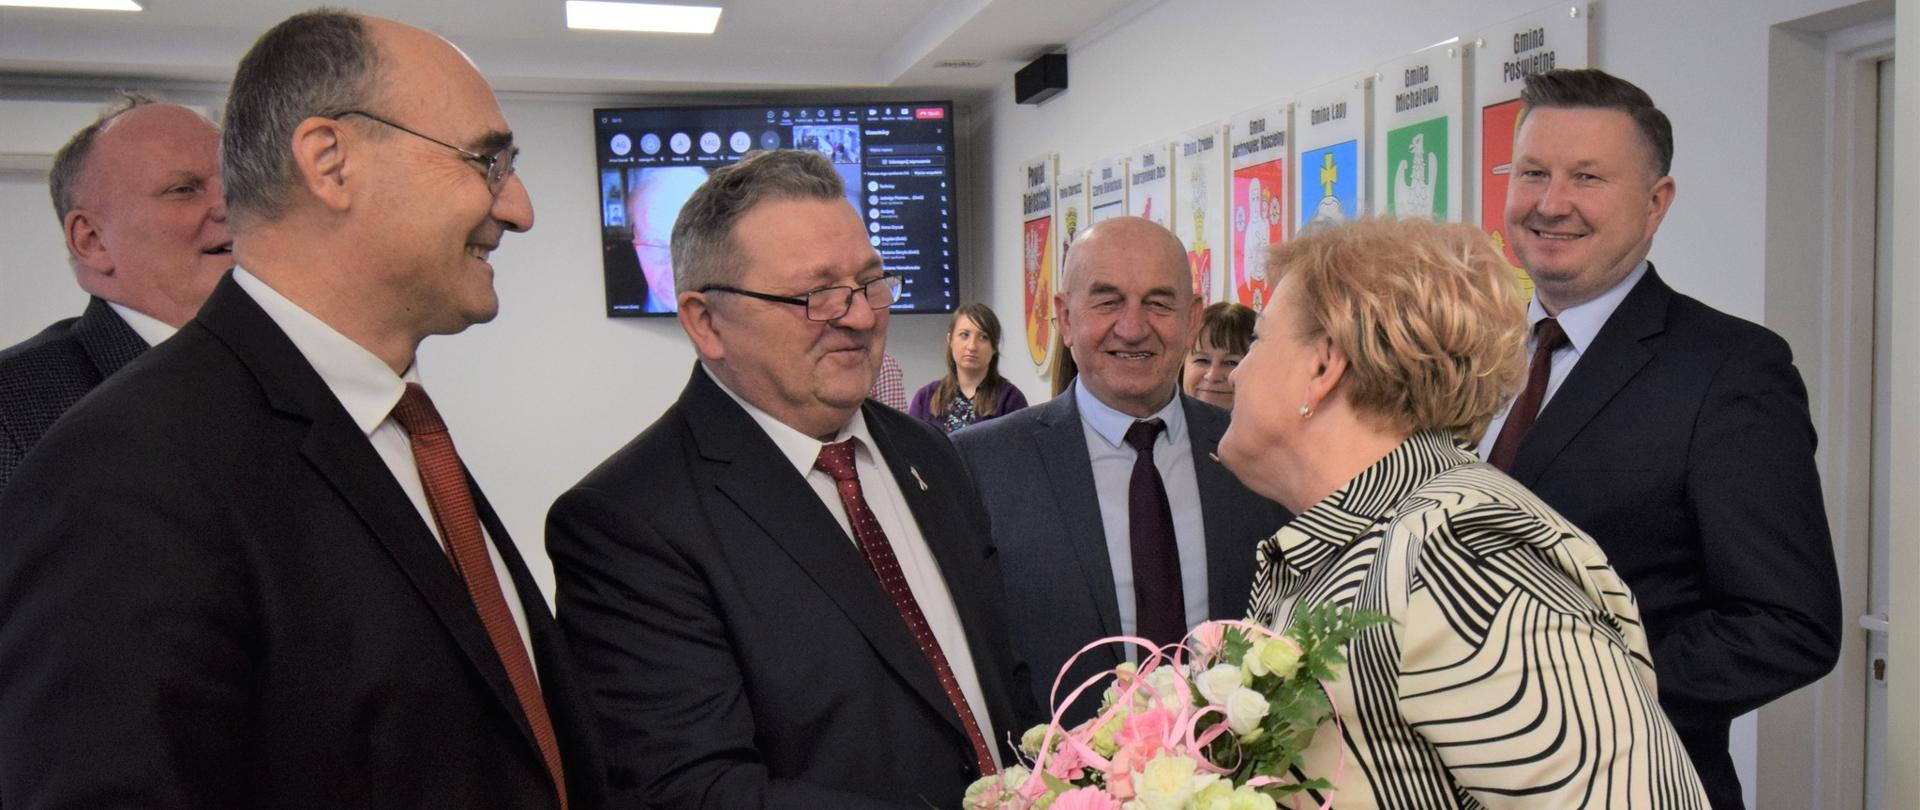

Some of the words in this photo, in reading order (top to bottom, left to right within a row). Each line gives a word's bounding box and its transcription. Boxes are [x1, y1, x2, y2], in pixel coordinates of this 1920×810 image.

[1513, 27, 1544, 54] Gmina
[1404, 65, 1429, 87] Gmina
[1311, 106, 1330, 125] Gmina
